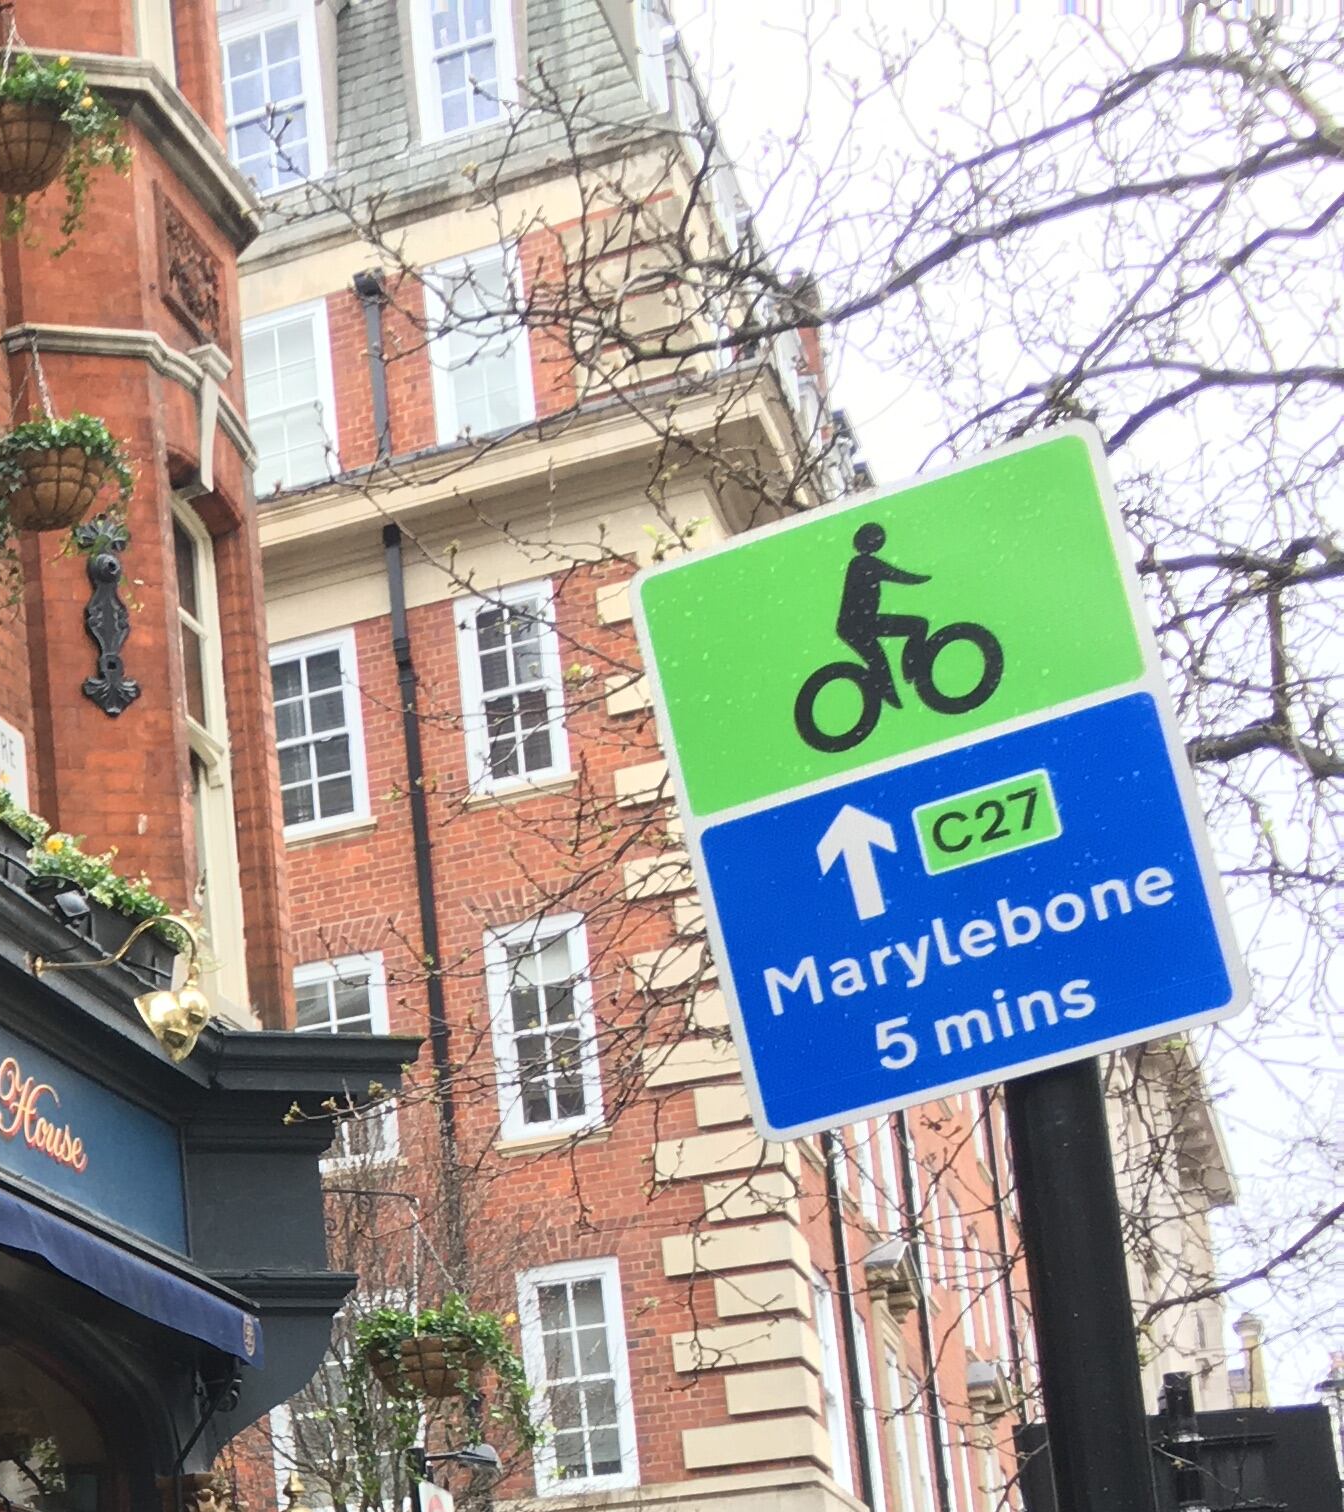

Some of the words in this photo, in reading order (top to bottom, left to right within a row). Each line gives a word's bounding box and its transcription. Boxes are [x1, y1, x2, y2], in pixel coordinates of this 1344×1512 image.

[931, 788, 1038, 854] C27
[763, 866, 1174, 1016] Marylebone
[876, 1017, 919, 1070] 5
[935, 978, 1097, 1056] mins
